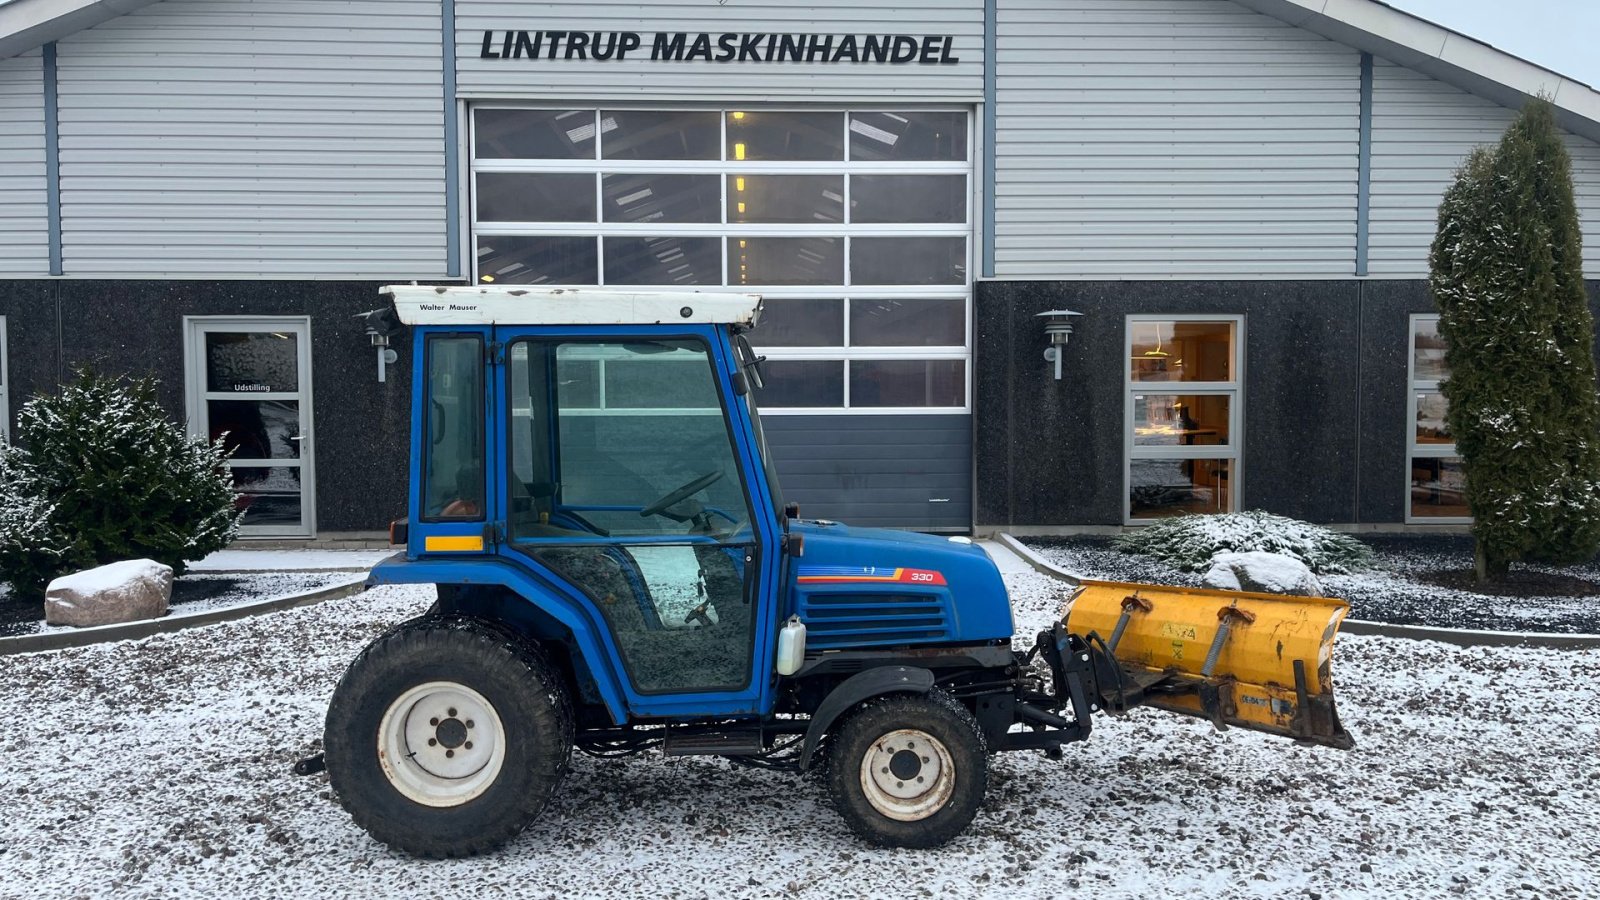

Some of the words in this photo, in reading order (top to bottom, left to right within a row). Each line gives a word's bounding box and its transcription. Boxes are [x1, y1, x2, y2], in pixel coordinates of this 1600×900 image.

[481, 30, 641, 61] LINTRUP
[651, 33, 960, 64] MASKINHANDEL
[234, 384, 271, 393] Udstilling
[911, 573, 933, 582] 330
